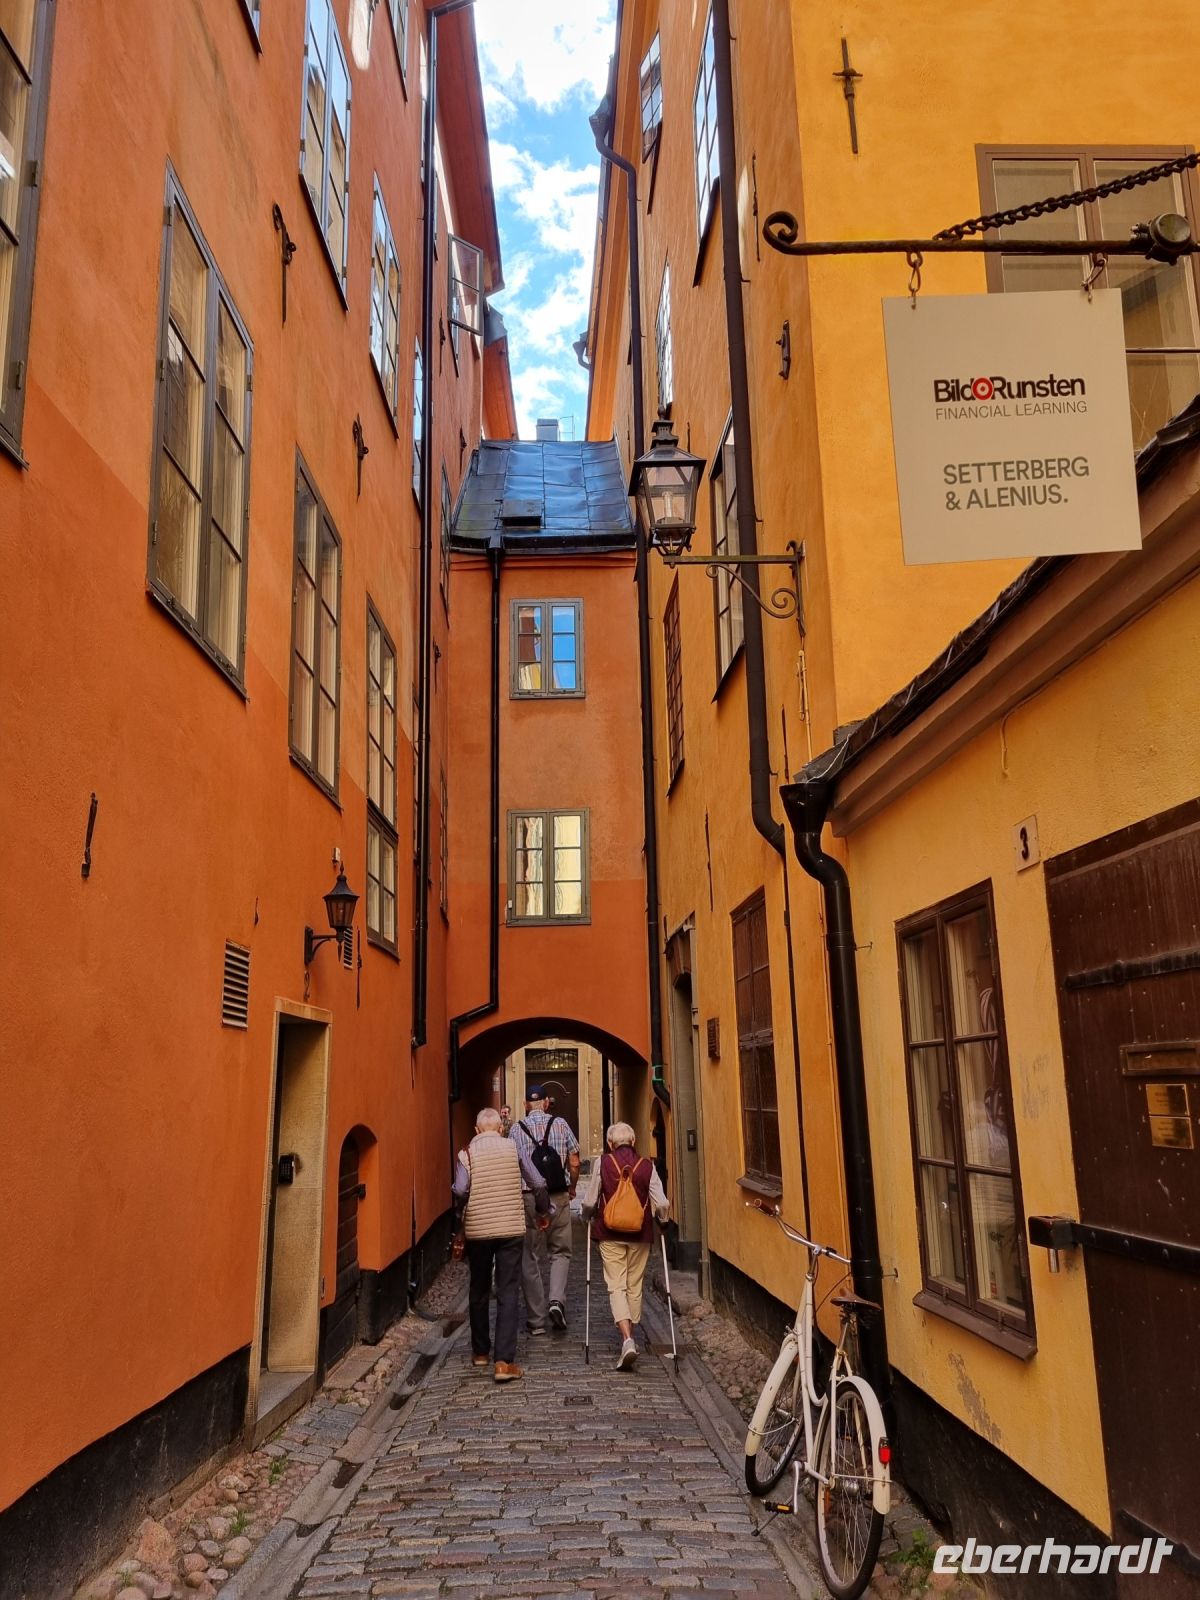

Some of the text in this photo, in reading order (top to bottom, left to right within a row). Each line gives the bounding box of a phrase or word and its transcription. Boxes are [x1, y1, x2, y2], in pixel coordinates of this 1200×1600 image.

[935, 401, 1088, 420] FINANCIAL LEARNING
[943, 457, 1089, 485] SETTERBERG
[945, 484, 1068, 511] & ALENIUS.
[1020, 827, 1029, 861] 3
